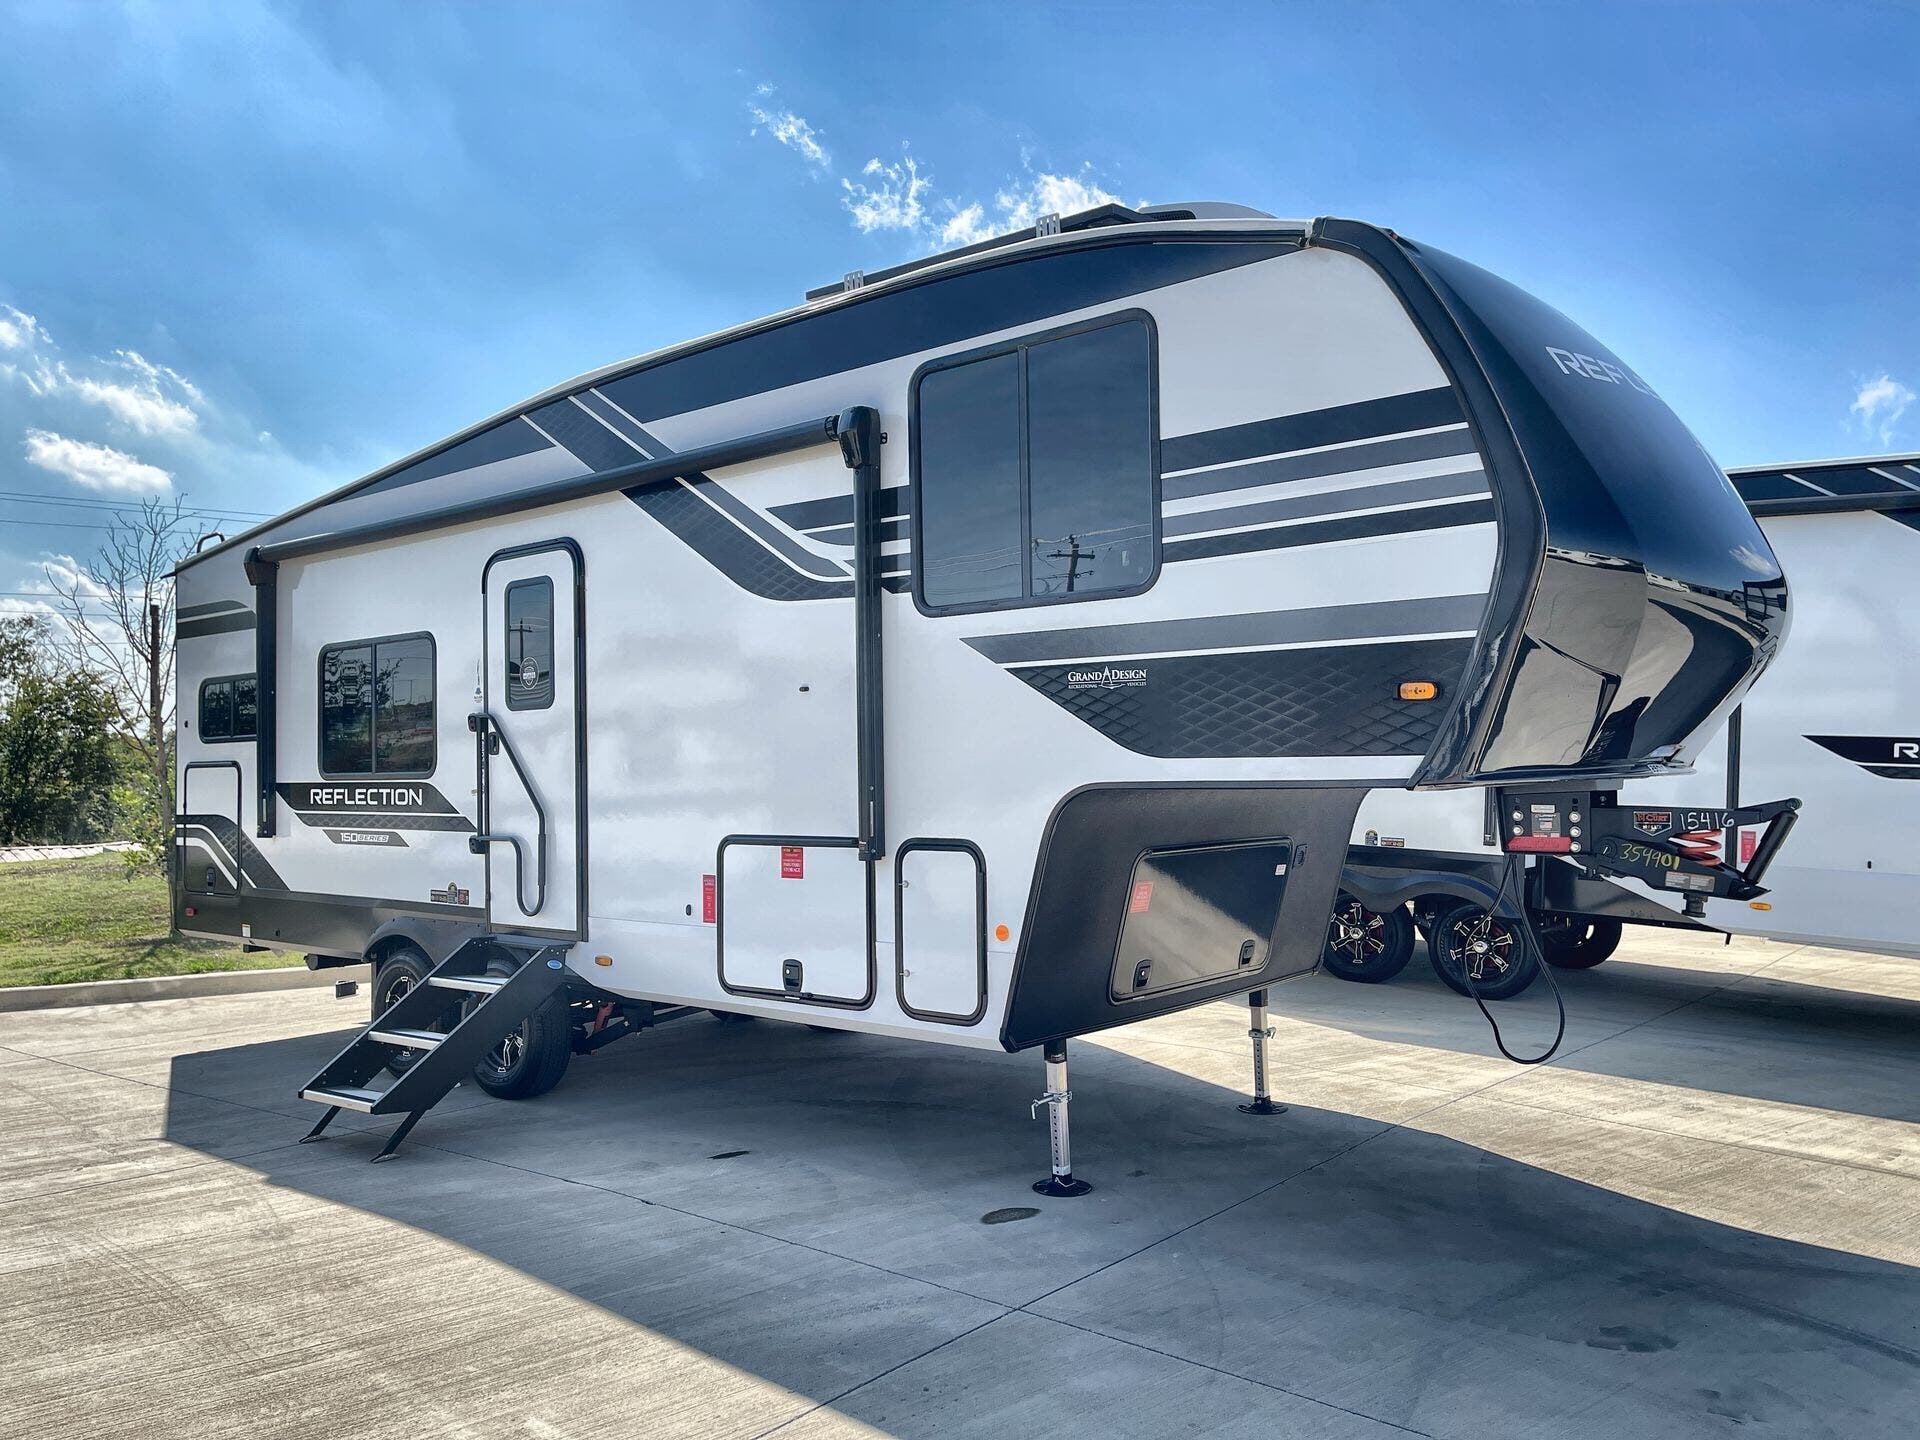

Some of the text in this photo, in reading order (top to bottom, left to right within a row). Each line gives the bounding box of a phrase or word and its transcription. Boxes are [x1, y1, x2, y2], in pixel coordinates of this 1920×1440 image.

[1545, 346, 1660, 400] REFL
[1067, 669, 1147, 682] GRAND DESIGN
[310, 788, 423, 806] REFLECTION
[1680, 812, 1735, 831] 15416
[340, 832, 358, 842] 150
